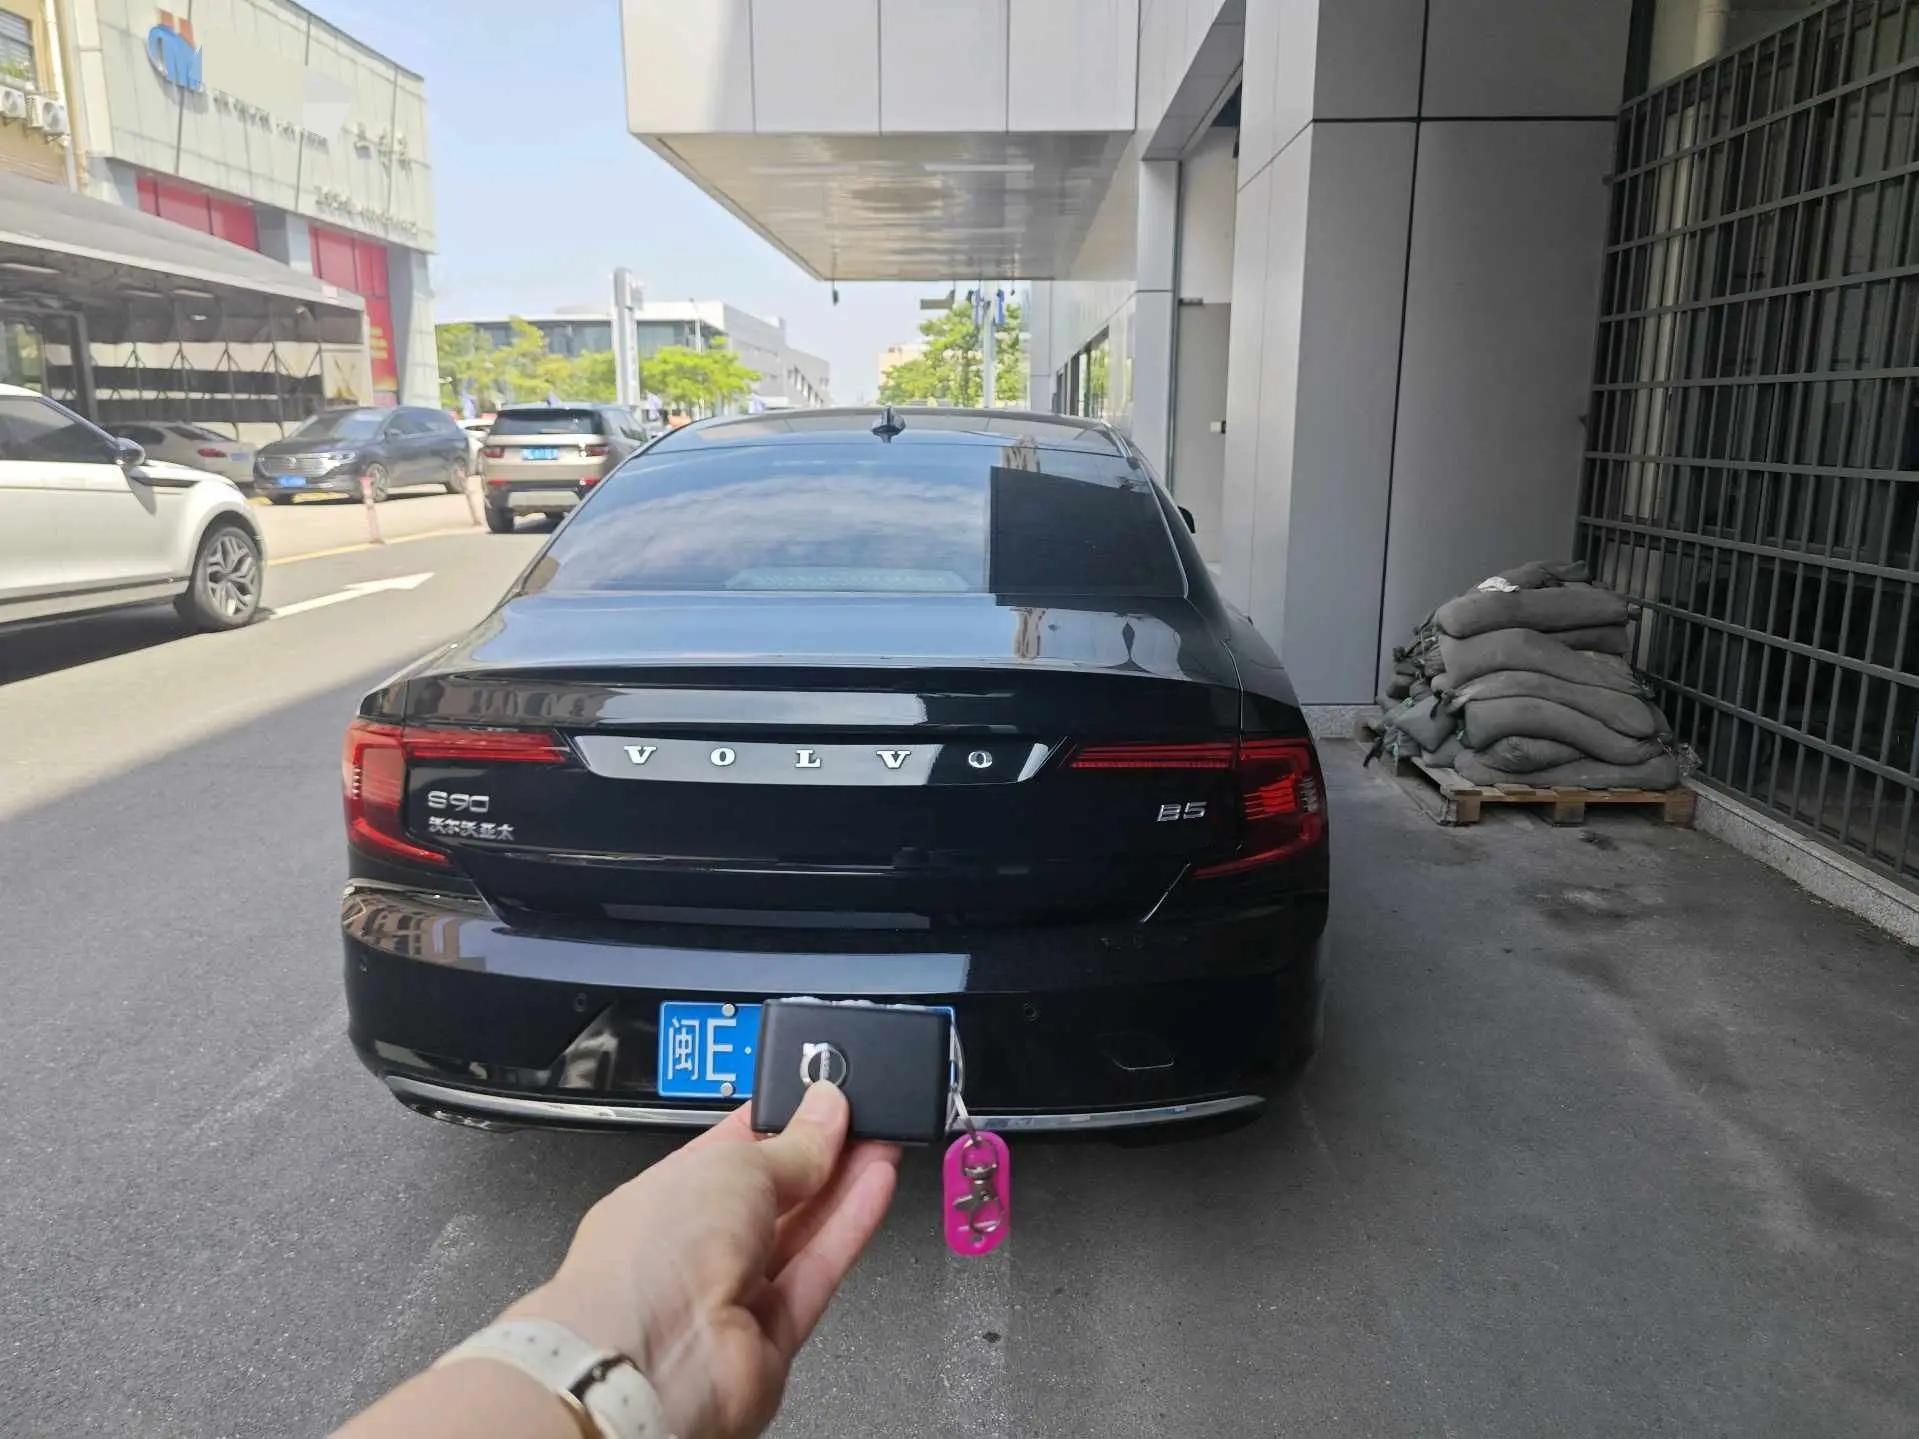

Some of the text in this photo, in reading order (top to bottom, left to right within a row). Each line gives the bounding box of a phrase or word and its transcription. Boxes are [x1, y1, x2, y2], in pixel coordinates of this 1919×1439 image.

[623, 744, 994, 769] VOLVO
[427, 790, 490, 813] S90
[1156, 800, 1207, 822] B5
